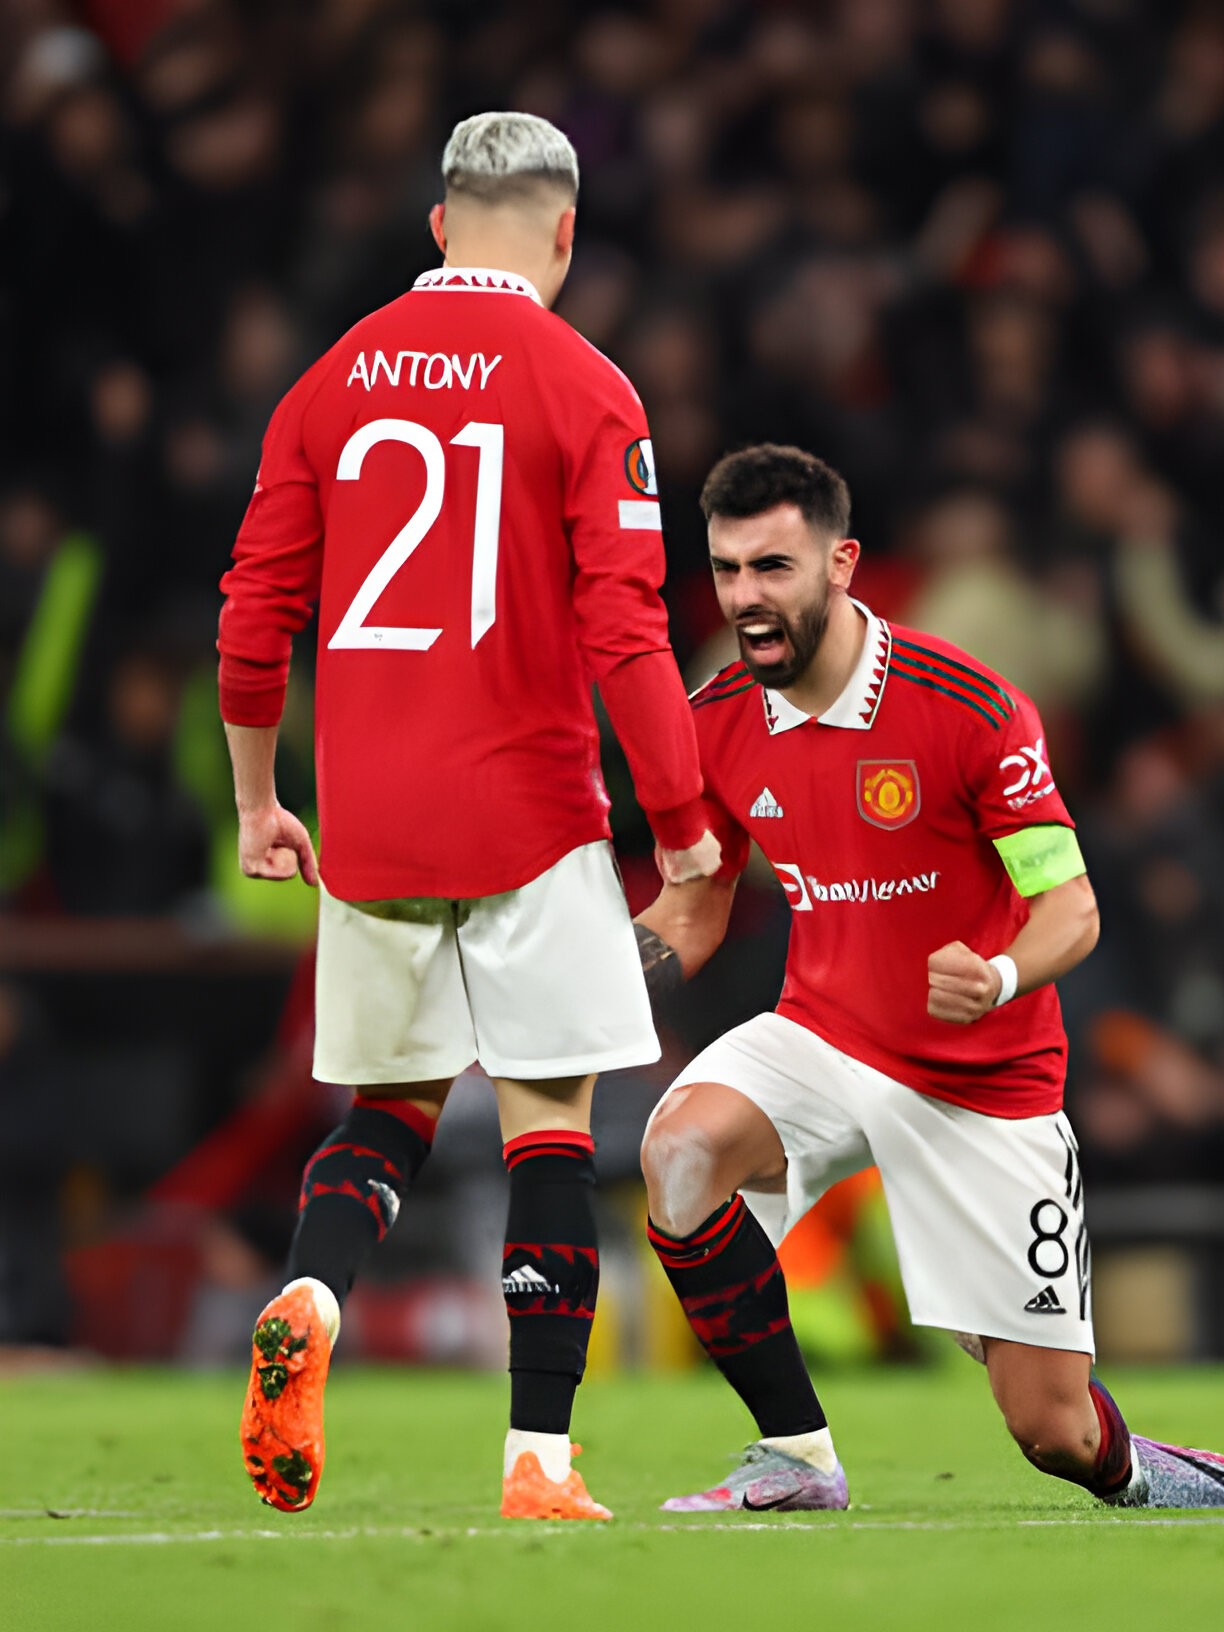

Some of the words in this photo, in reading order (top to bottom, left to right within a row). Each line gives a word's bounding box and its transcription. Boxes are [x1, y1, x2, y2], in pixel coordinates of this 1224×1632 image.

[347, 350, 502, 391] ANTONY
[328, 418, 504, 651] 21
[1027, 1198, 1069, 1279] 8
